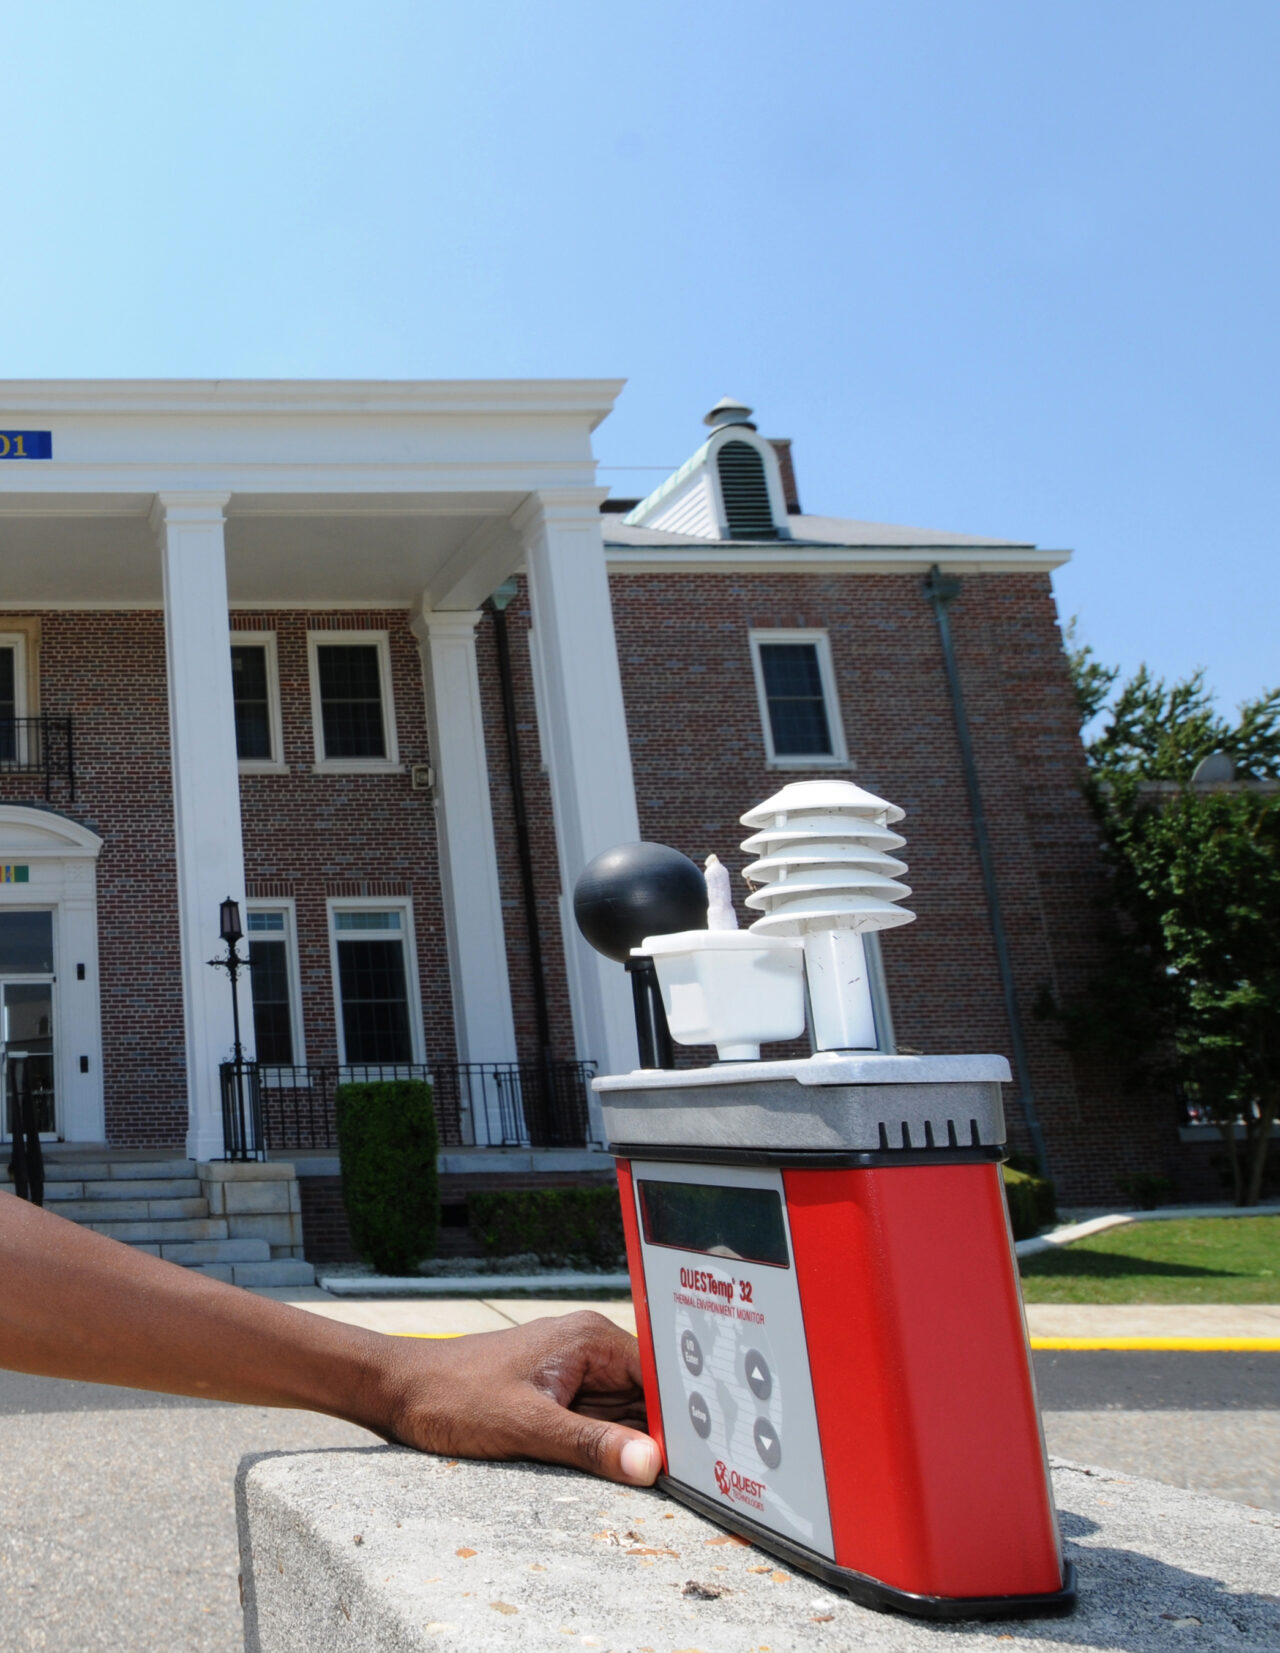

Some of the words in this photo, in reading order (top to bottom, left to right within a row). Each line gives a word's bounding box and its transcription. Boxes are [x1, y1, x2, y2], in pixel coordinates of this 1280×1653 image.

[739, 1279, 754, 1304] 32
[673, 1292, 696, 1308] THERMAL
[696, 1298, 736, 1318] ENVIRONMENT
[736, 1307, 766, 1325] MONITOR
